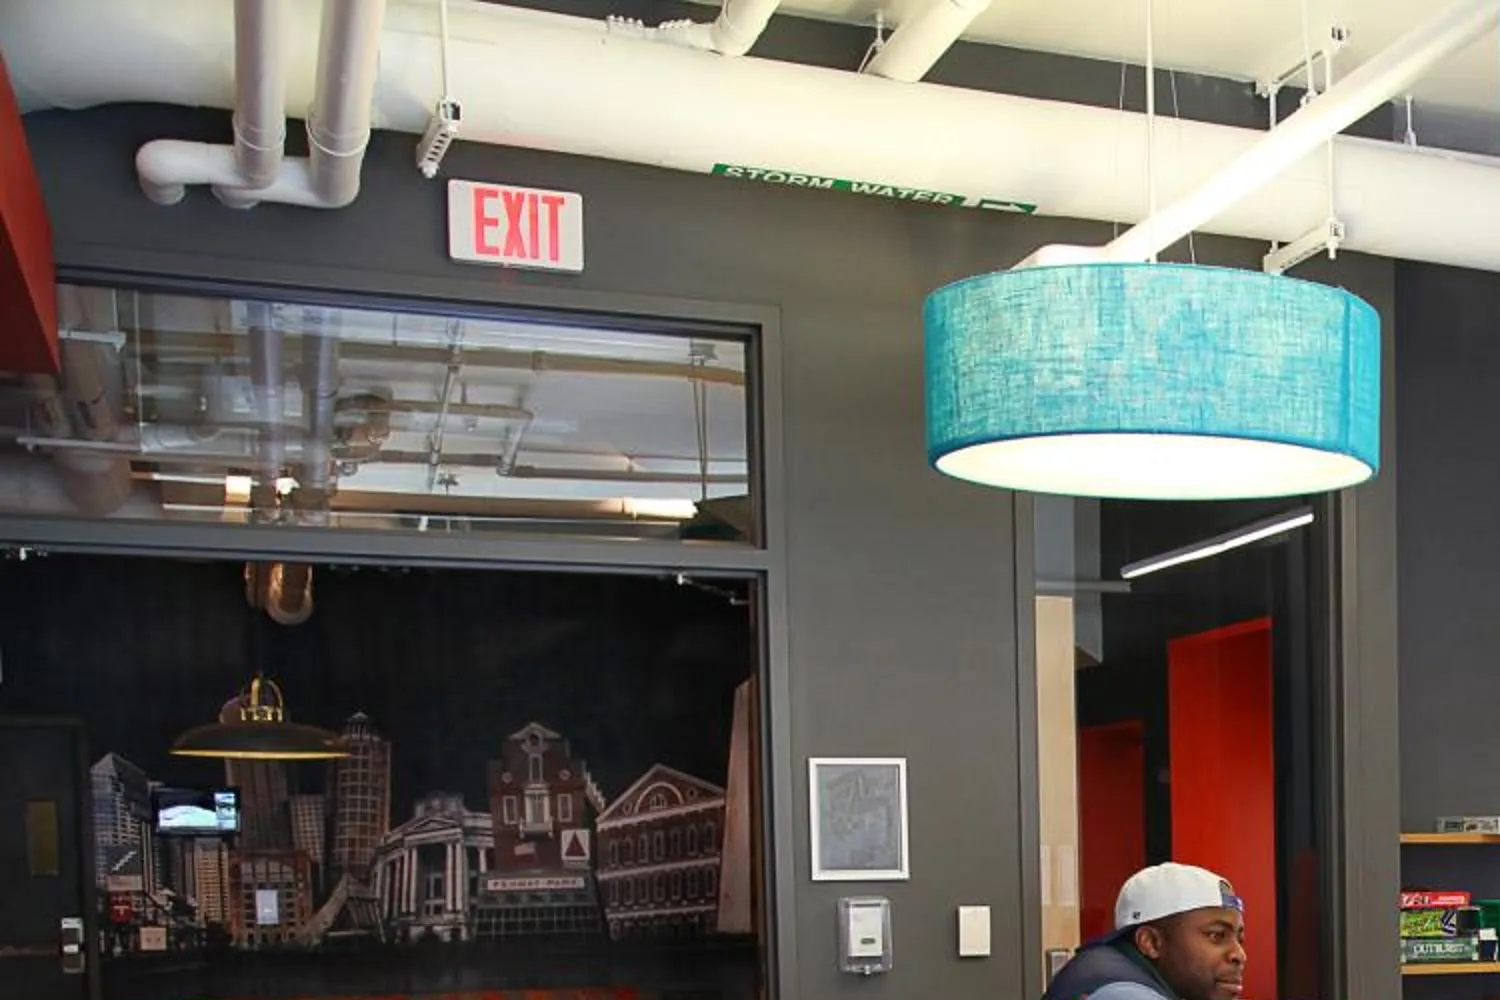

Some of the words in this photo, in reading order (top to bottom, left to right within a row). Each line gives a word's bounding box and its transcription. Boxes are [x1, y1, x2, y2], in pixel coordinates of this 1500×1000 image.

[724, 166, 833, 189] STORM
[851, 182, 955, 205] WATER
[474, 187, 564, 262] EXIT
